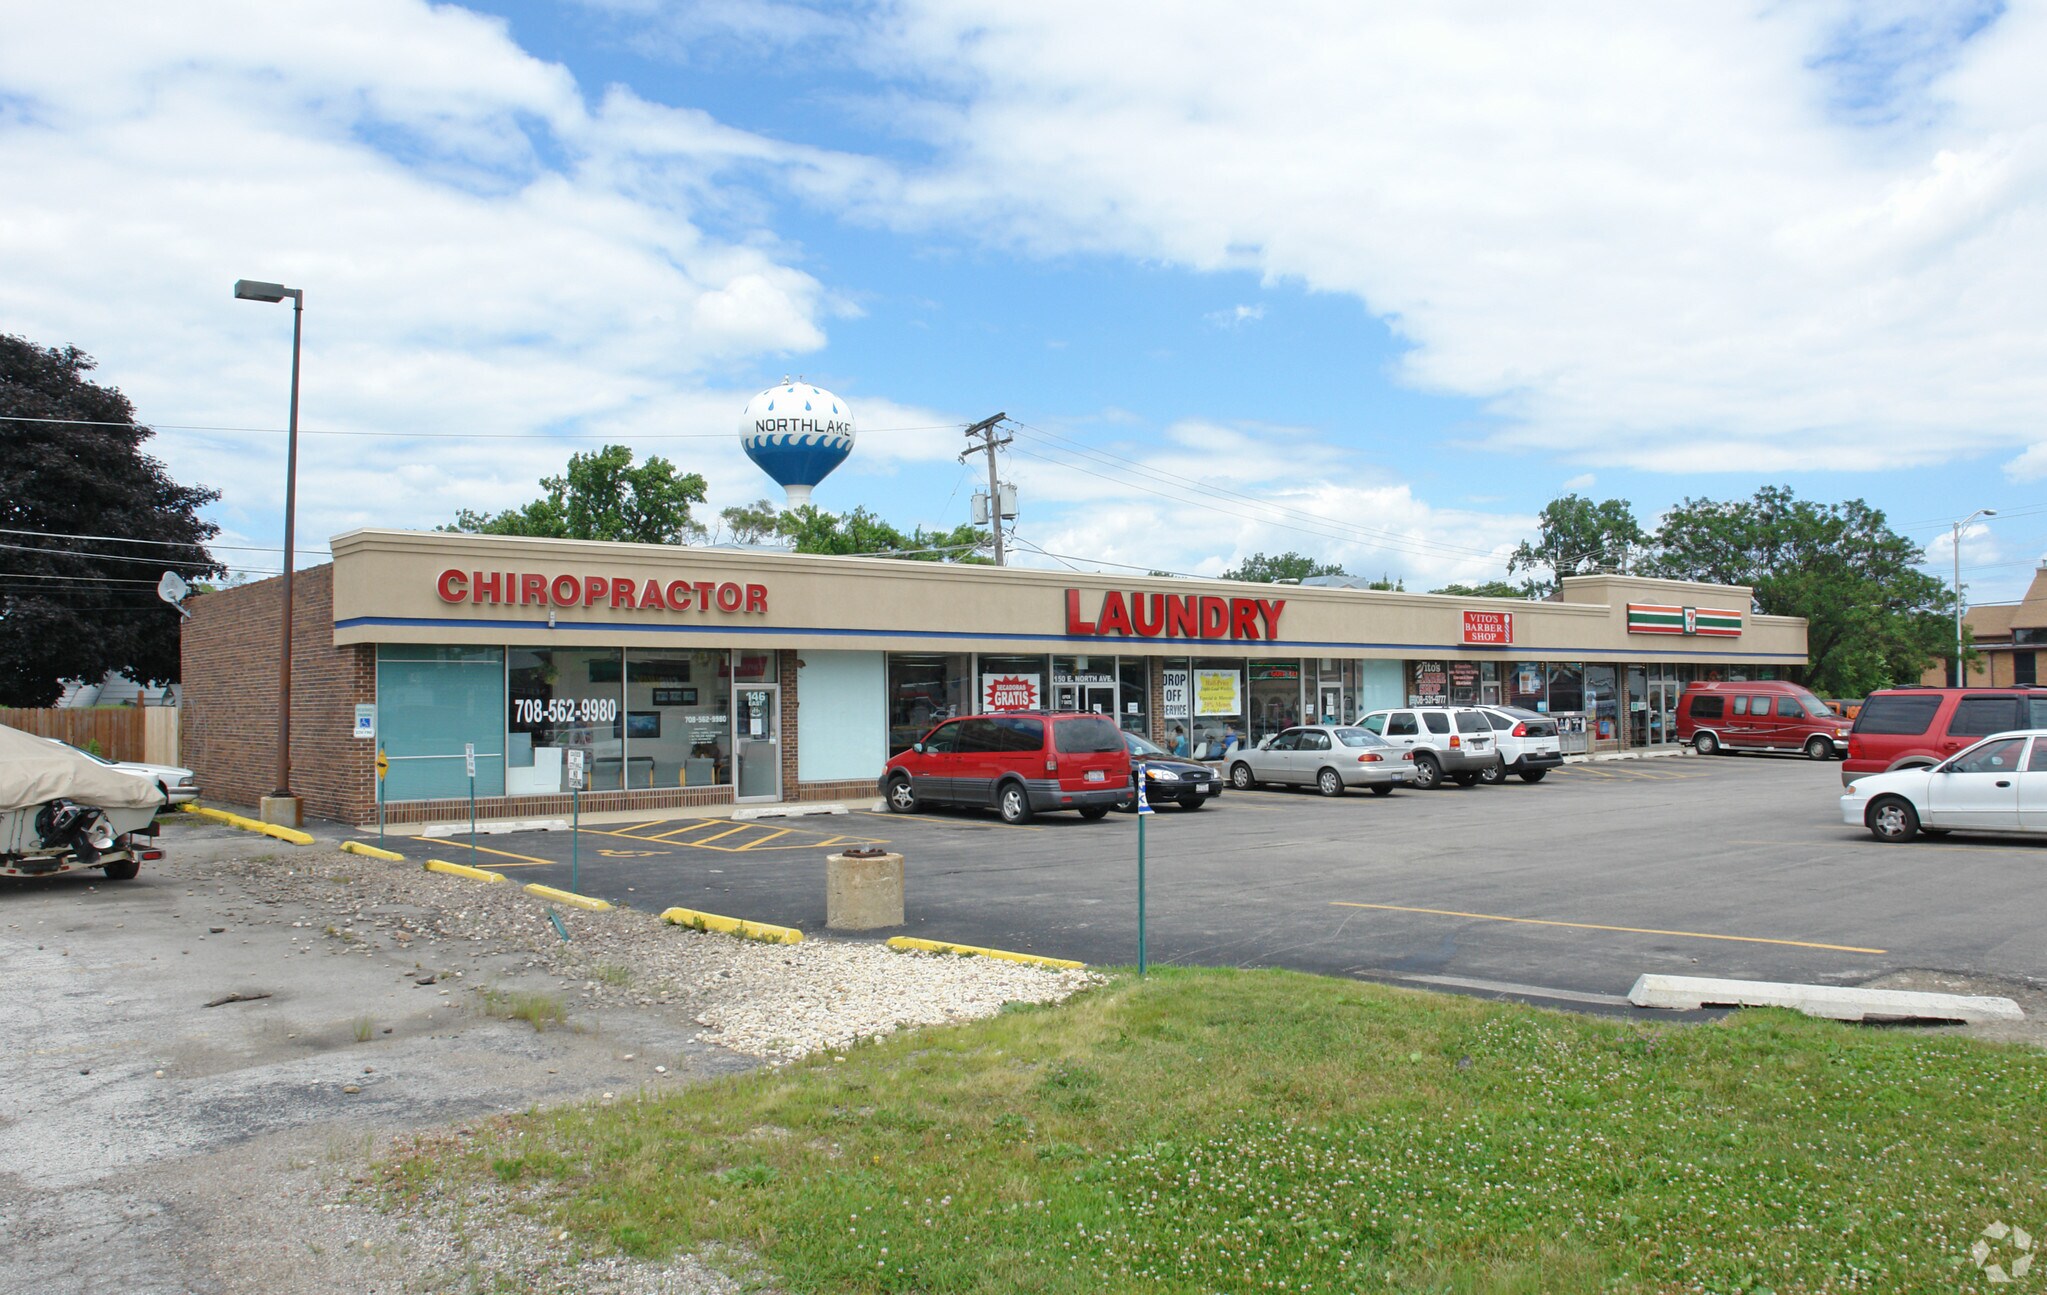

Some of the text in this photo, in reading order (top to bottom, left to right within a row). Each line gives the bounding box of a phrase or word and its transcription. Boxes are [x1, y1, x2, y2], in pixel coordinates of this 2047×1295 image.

[755, 418, 851, 437] NORTHLAKE
[435, 568, 769, 613] CHIROPRACTOR
[1064, 588, 1287, 640] LAUNDRY
[1470, 614, 1499, 623] VITO'S
[1465, 623, 1503, 632] BARBER
[1471, 632, 1497, 641] SHOP
[1163, 673, 1186, 686] DROP
[746, 691, 766, 701] 146
[994, 690, 1029, 706] GRATIS
[1166, 689, 1182, 702] OFF
[514, 698, 617, 723] 708-562-9980
[1163, 704, 1187, 715] ERVICE
